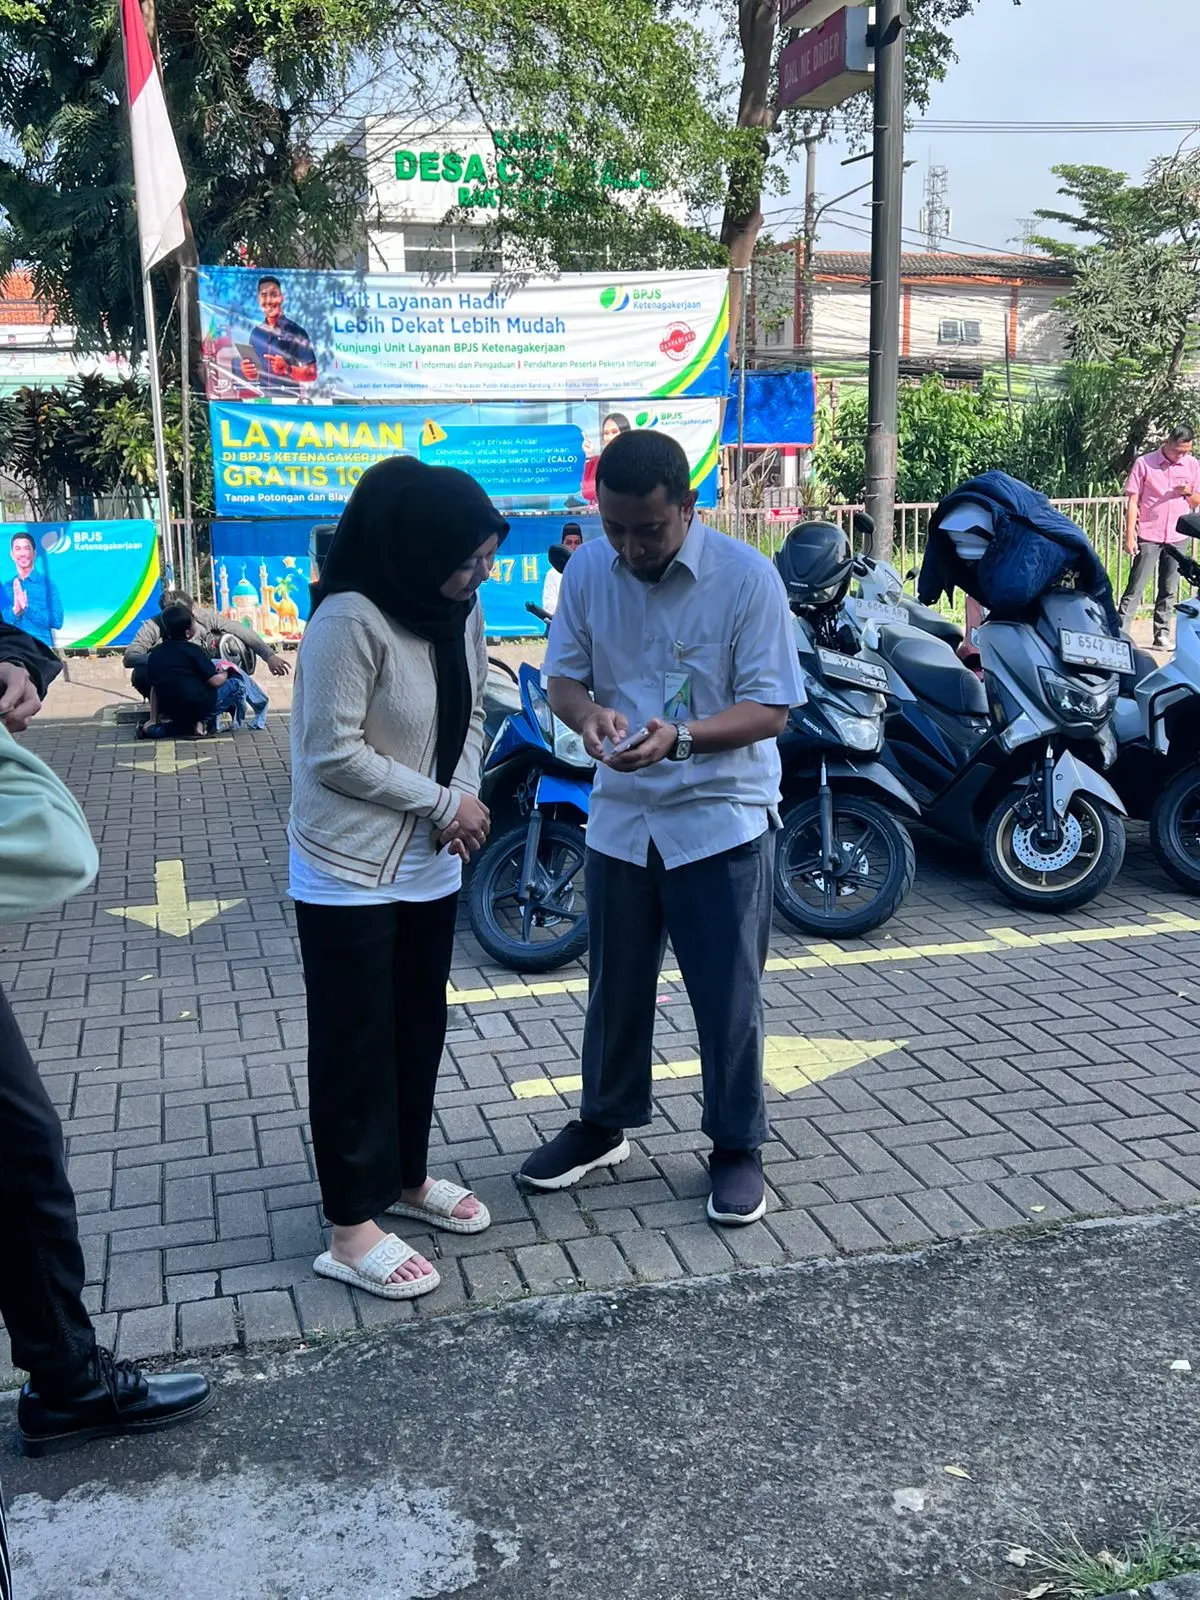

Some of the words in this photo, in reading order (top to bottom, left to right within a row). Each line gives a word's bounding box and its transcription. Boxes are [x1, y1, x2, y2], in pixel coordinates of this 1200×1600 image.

[394, 150, 488, 185] DESA
[633, 289, 661, 299] BPJS
[333, 292, 370, 309] Unit
[377, 293, 453, 312] Layanan
[459, 292, 507, 309] Hadir
[633, 301, 701, 310] Ketenagakerjaan
[333, 317, 385, 334] Lebih
[392, 317, 445, 333] Dekat
[451, 317, 501, 333] Lebih
[507, 316, 566, 333] Mudah
[335, 343, 381, 354] Kunjungi
[384, 343, 405, 352] Unit
[409, 343, 451, 354] Layanan
[454, 342, 478, 352] BPJS
[482, 343, 566, 354] Ketenagakerjaan
[399, 361, 412, 369] JHT
[421, 361, 459, 369] Informasi
[461, 361, 473, 369] dan
[475, 361, 515, 370] Pengaduan
[524, 360, 568, 369] Pendaftaran
[570, 360, 596, 368] Peserta
[599, 360, 625, 369] Pekerja
[627, 360, 657, 368] Informal
[661, 412, 683, 420] BPJS
[220, 419, 404, 448] LAYANAN
[222, 452, 237, 462] DI
[240, 452, 271, 462] BPJS
[274, 452, 404, 463] KETENAGAKERJA
[223, 465, 328, 487] GRATIS
[224, 493, 255, 503] Tanpa
[258, 493, 305, 503] Potongan
[307, 493, 326, 501] dan
[328, 493, 351, 502] Biay
[73, 531, 102, 542] BPJS
[74, 542, 143, 551] Ketenagakerjaan
[523, 555, 538, 582] H
[1064, 633, 1071, 646] D
[1078, 635, 1104, 652] 6542
[802, 717, 823, 736] HONDA
